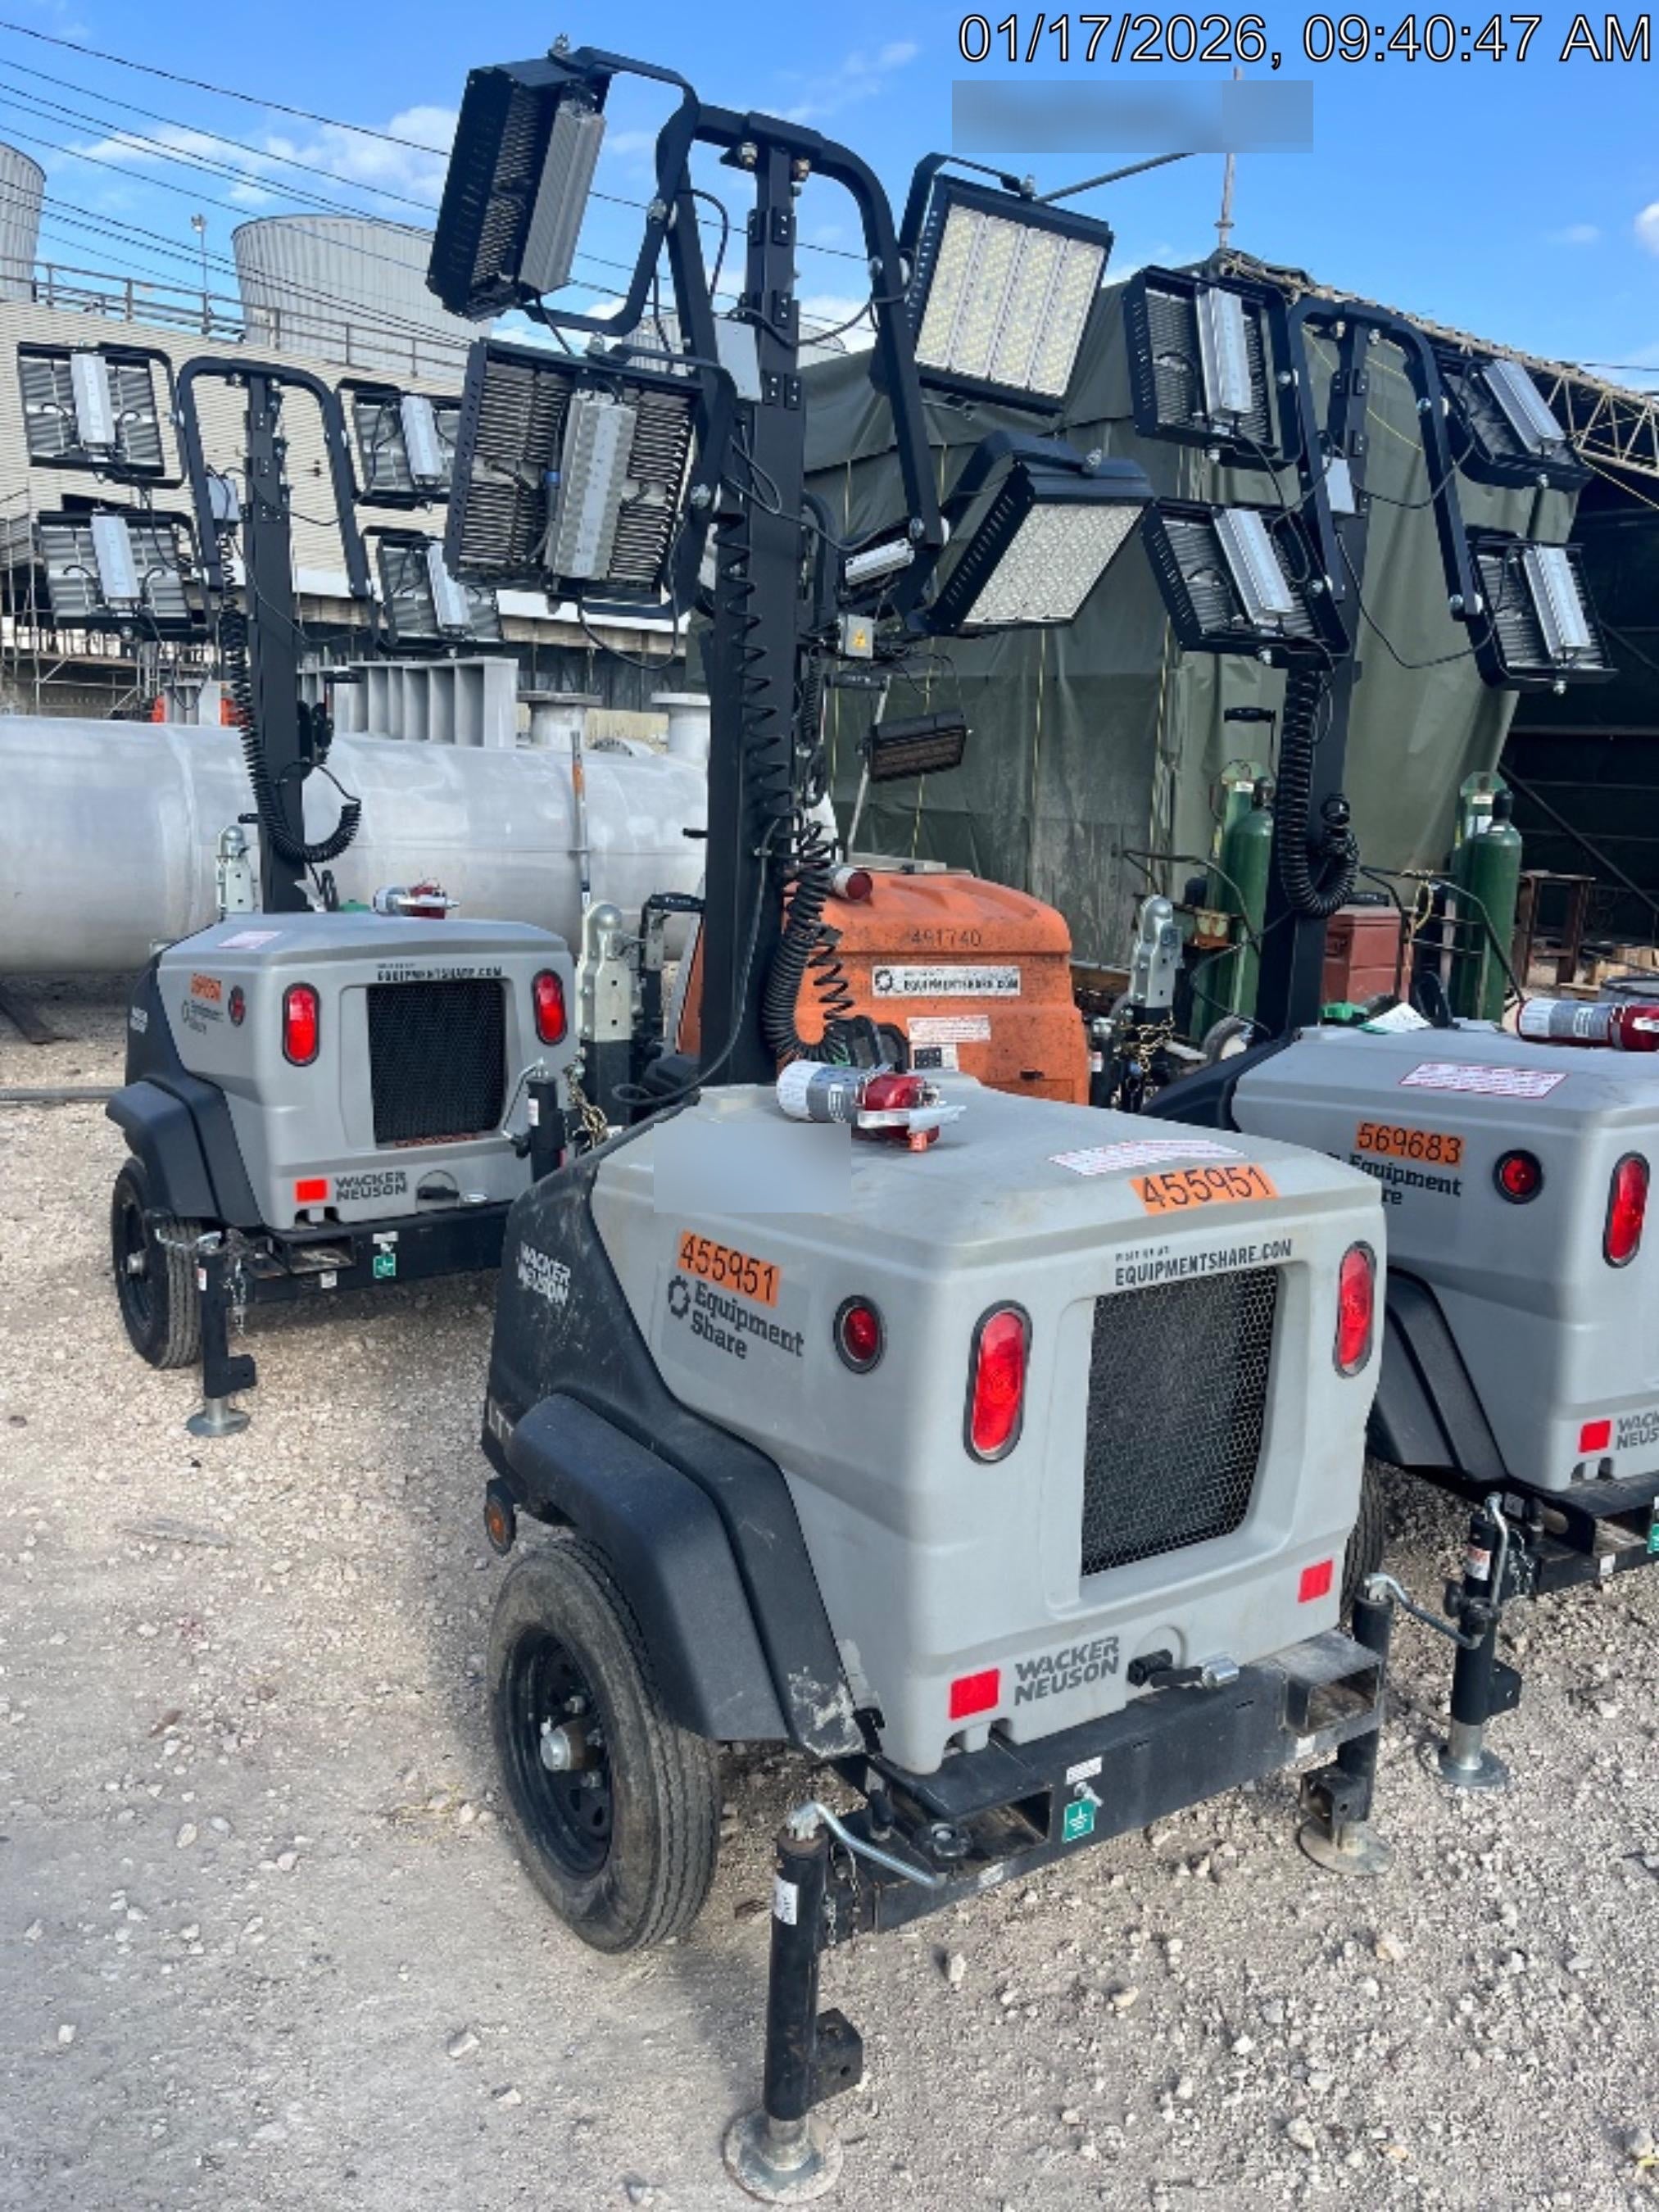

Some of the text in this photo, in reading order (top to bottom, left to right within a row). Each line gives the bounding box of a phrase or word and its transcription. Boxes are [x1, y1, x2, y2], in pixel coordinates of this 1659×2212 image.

[1358, 1122, 1462, 1164] 569683
[334, 1172, 406, 1188] WACKER
[336, 1185, 407, 1203] NEUSON
[1143, 1166, 1271, 1208] 455951
[680, 1235, 776, 1302] 455951
[691, 1309, 748, 1360] Share
[695, 1280, 805, 1357] Equipment
[1014, 1636, 1119, 1681] WACKER
[1014, 1656, 1119, 1706] NEUSON
